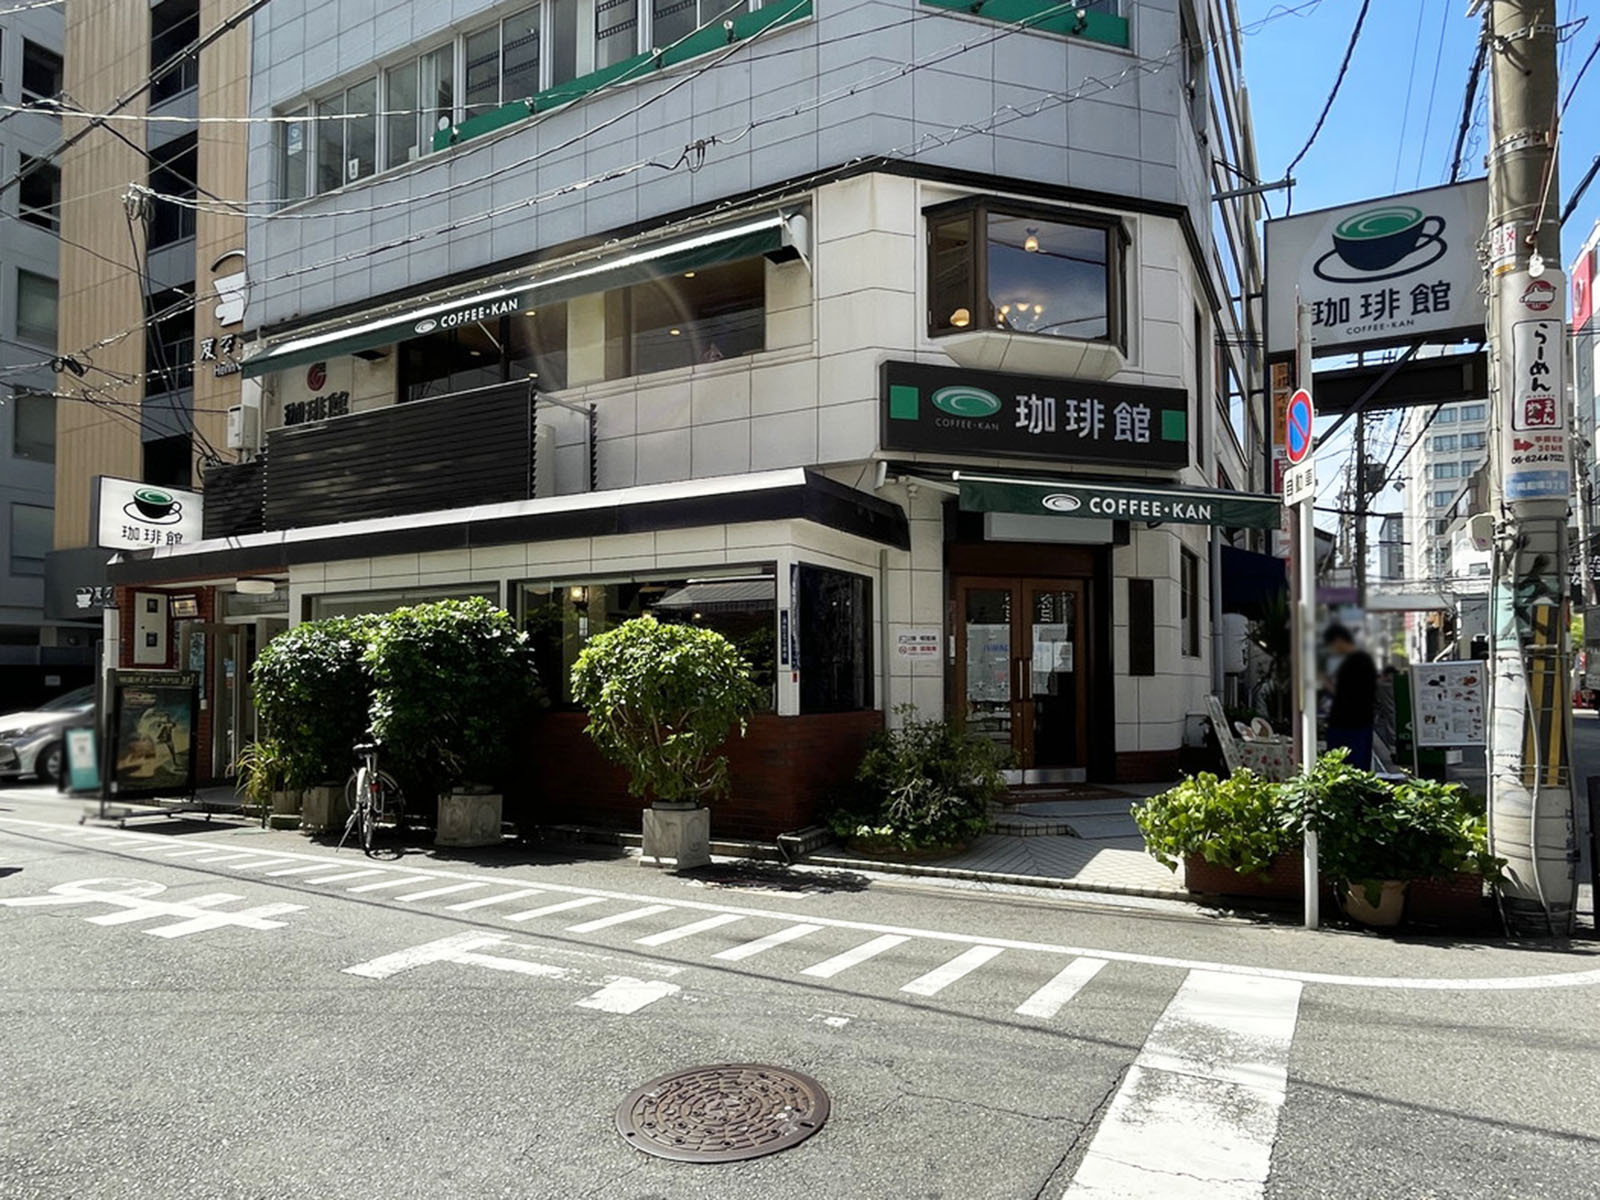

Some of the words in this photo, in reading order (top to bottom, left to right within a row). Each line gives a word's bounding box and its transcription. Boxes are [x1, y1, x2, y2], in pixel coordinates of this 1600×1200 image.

[1311, 280, 1451, 327] 珈琲館
[1529, 322, 1552, 392] らーめん
[1014, 393, 1151, 444] 珈琲館
[121, 525, 184, 546] 珈琲館
